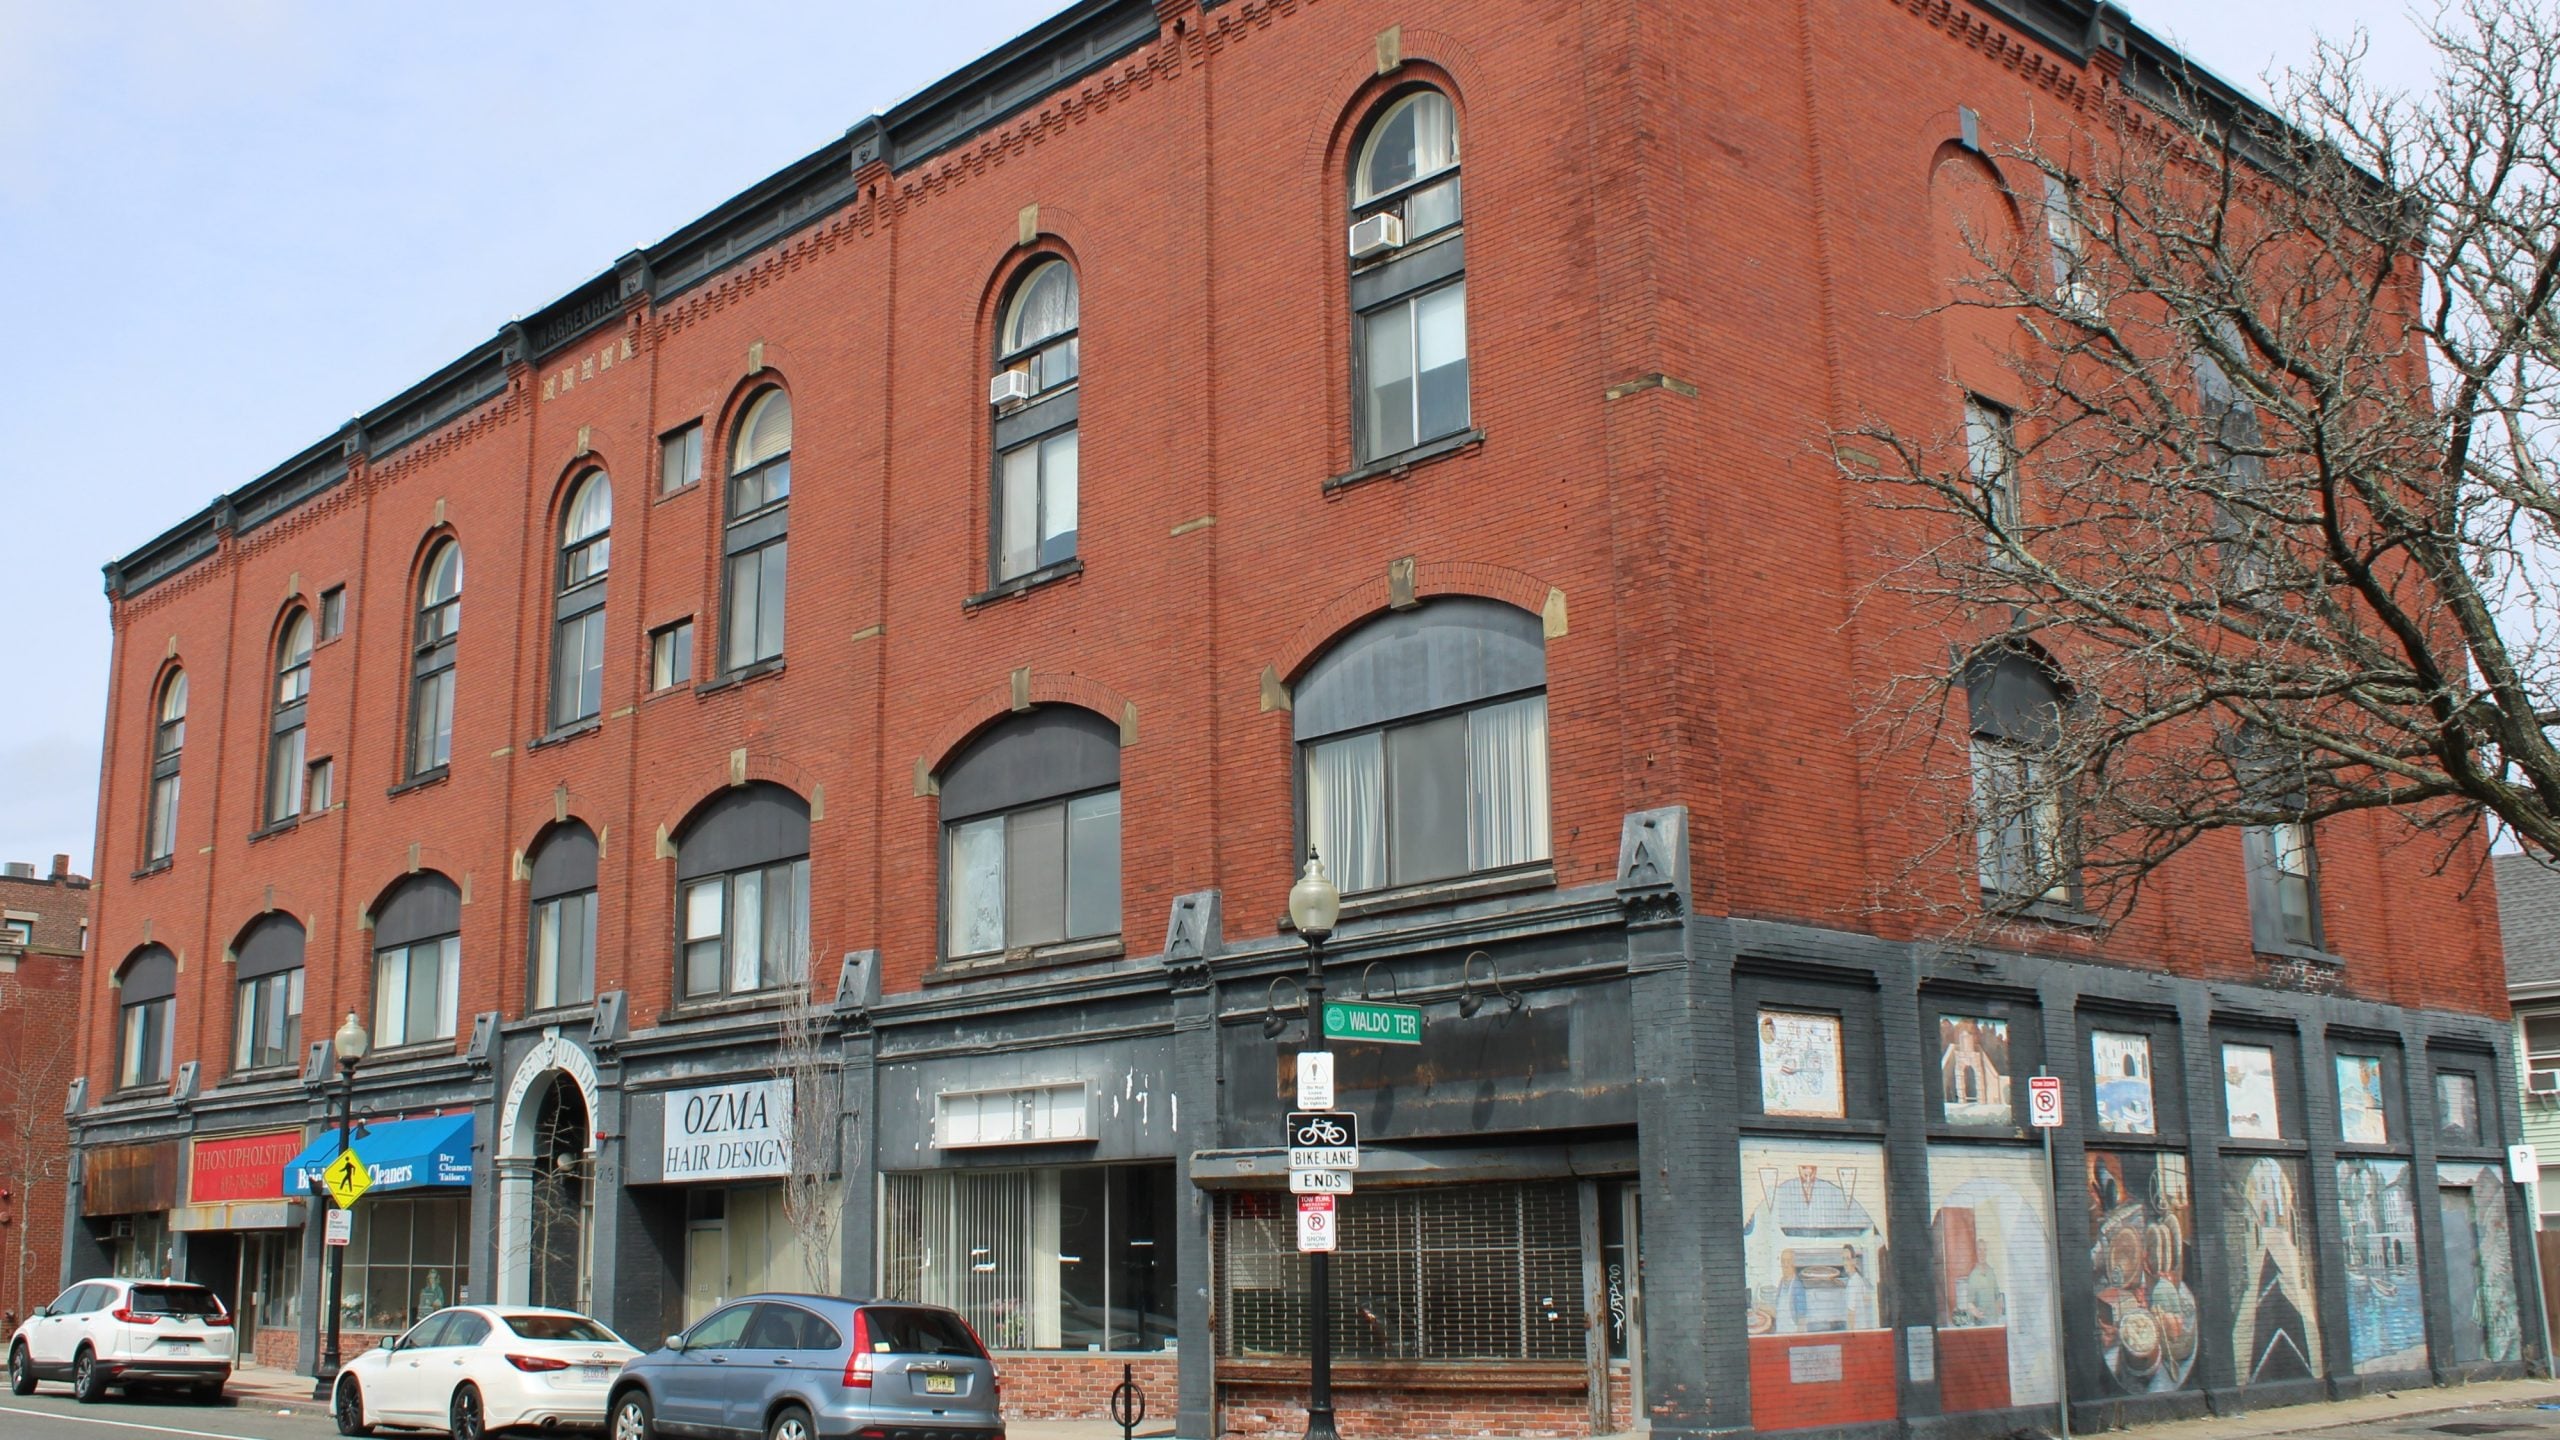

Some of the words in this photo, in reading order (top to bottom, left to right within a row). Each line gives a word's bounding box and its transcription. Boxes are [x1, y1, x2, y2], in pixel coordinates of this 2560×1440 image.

[1349, 1010, 1390, 1033] WALDO
[1394, 1013, 1416, 1034] TER
[684, 1090, 769, 1135] OZMA
[197, 1148, 227, 1171] THO'S
[228, 1142, 300, 1168] UPHOLSTERY
[440, 1153, 455, 1163] Dry
[666, 1144, 710, 1173] HAIR
[717, 1139, 787, 1170] DESIGN
[1295, 1151, 1321, 1165] BIKE
[1325, 1150, 1353, 1165] LANE
[367, 1163, 412, 1186] Cleaners
[438, 1173, 465, 1181] Tailors
[439, 1163, 472, 1172] Cleaners
[1304, 1174, 1341, 1188] ENDS
